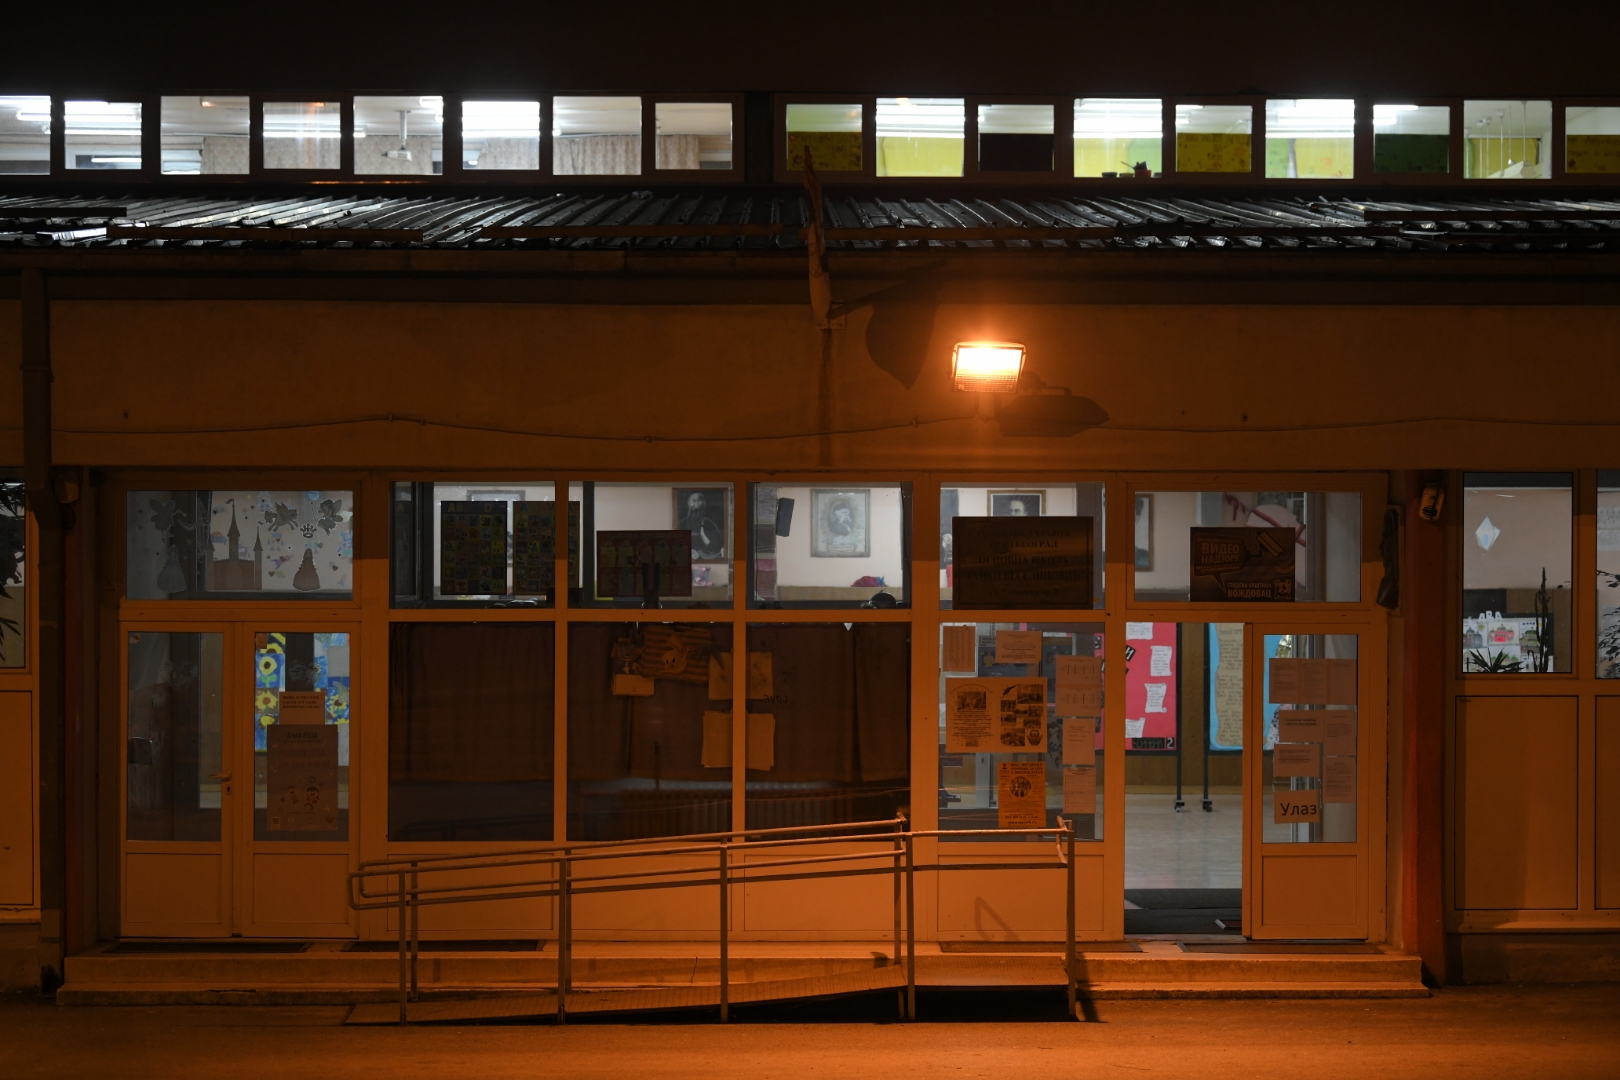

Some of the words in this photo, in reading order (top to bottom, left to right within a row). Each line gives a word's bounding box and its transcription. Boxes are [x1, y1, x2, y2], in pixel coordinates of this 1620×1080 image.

[1202, 542, 1240, 554] ВИДЕО
[978, 556, 1028, 564] ОСНОВНА
[1202, 554, 1240, 564] НАДЗОРУ
[1228, 589, 1272, 598] ВОЖДОВАЦ
[1280, 802, 1318, 816] Улаз
